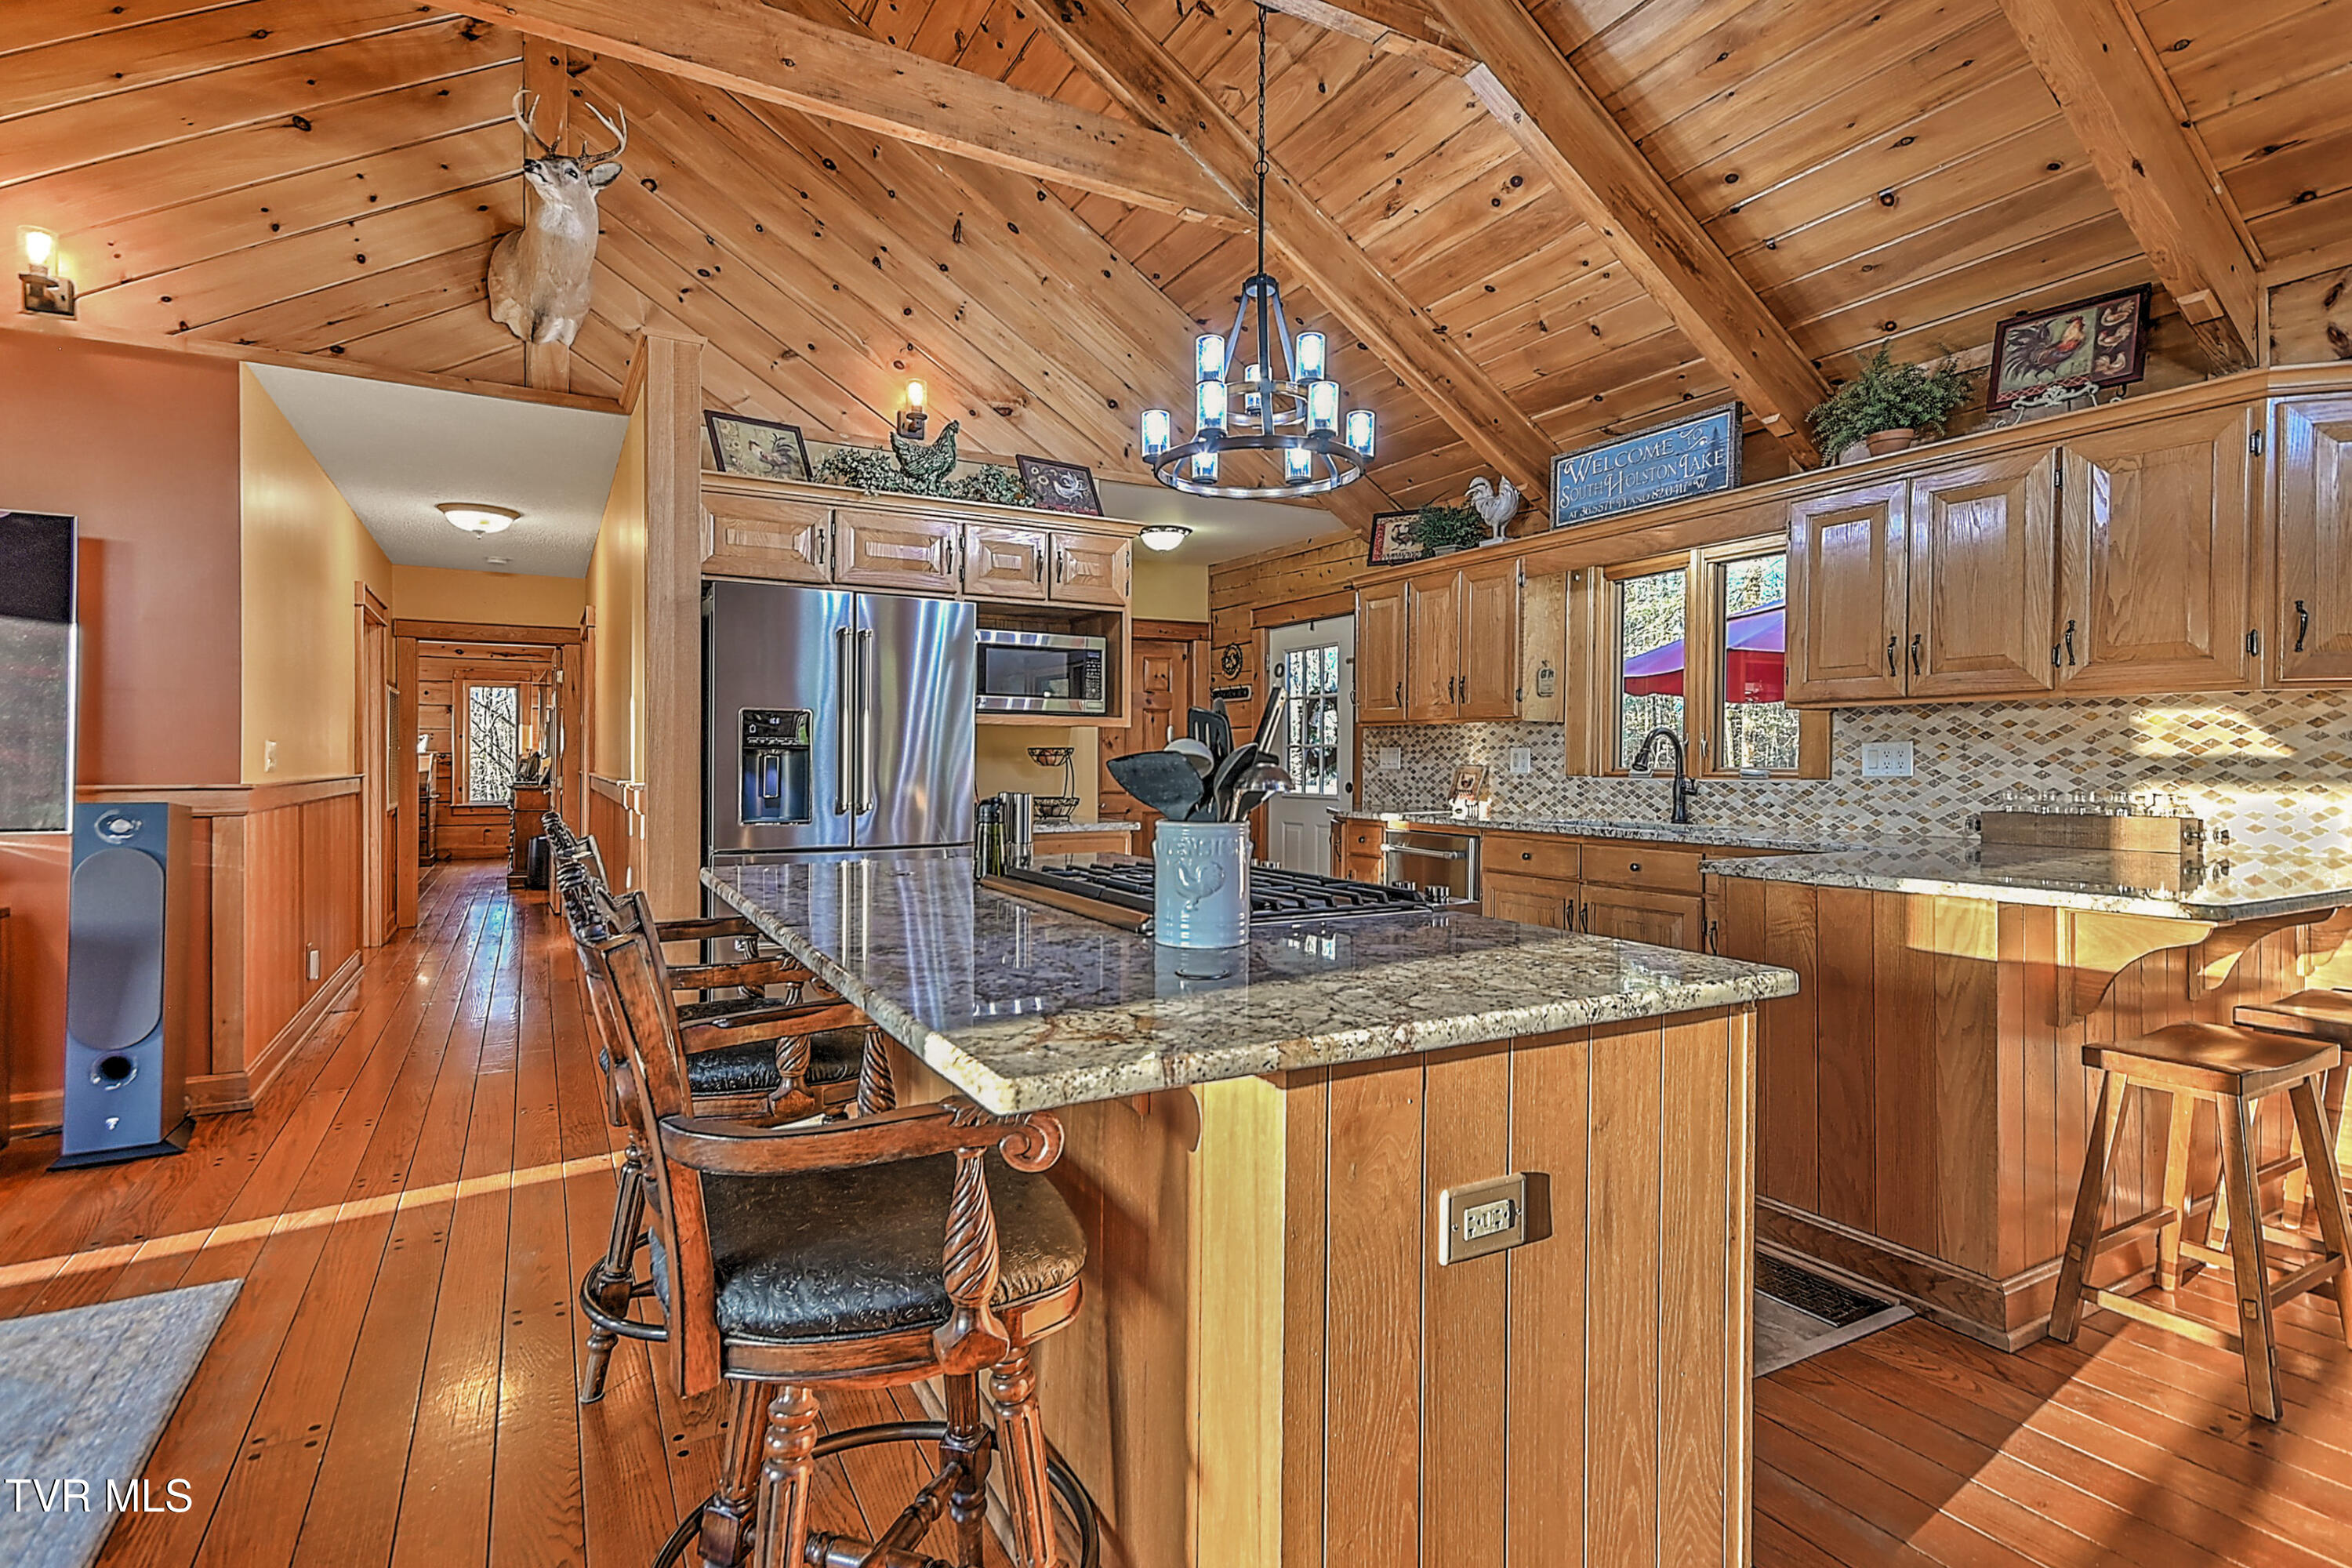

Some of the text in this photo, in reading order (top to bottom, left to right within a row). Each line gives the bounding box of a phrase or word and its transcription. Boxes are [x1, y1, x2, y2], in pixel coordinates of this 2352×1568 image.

[1560, 448, 1726, 509] SOUTH HOLSTON LAKE
[1564, 423, 1708, 485] WELCOME TO
[1568, 510, 1578, 520] AT
[1630, 492, 1650, 505] AND
